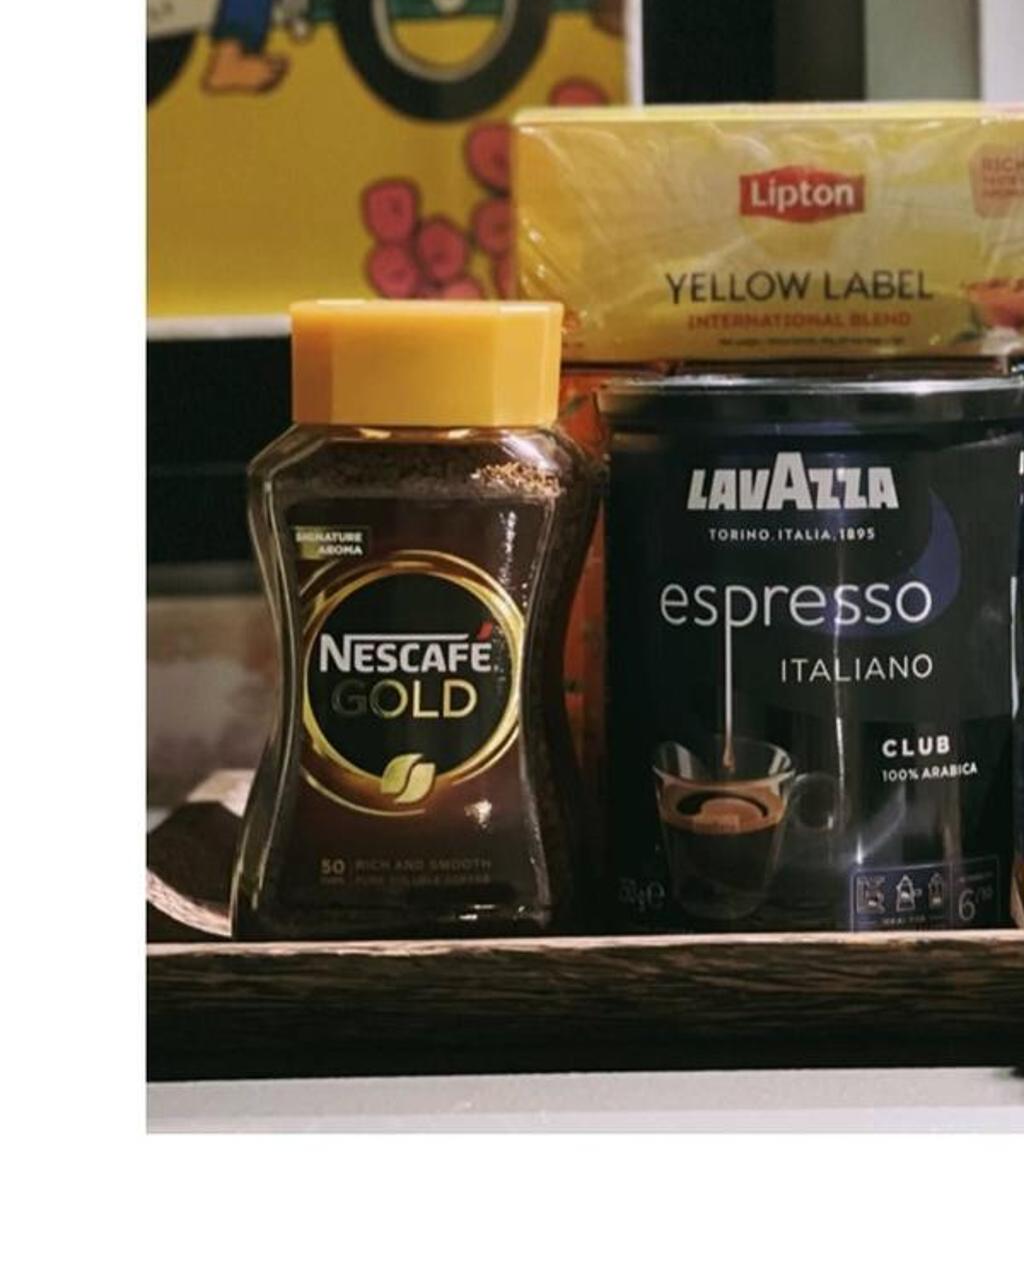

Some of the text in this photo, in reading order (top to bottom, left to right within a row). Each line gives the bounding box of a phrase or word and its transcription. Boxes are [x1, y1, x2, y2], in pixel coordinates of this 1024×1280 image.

[751, 177, 855, 213] Lipton
[665, 270, 934, 304] YELLOW LABEL
[688, 311, 911, 331] INTERNATIONAL BLEND
[687, 452, 899, 511] LAVAZZA
[660, 581, 932, 628] espresso
[782, 653, 933, 683] ITALIANO
[331, 678, 478, 719] GOLD
[882, 734, 950, 758] CLUB
[882, 761, 978, 782] 100% ARABICA
[320, 858, 346, 875] 50
